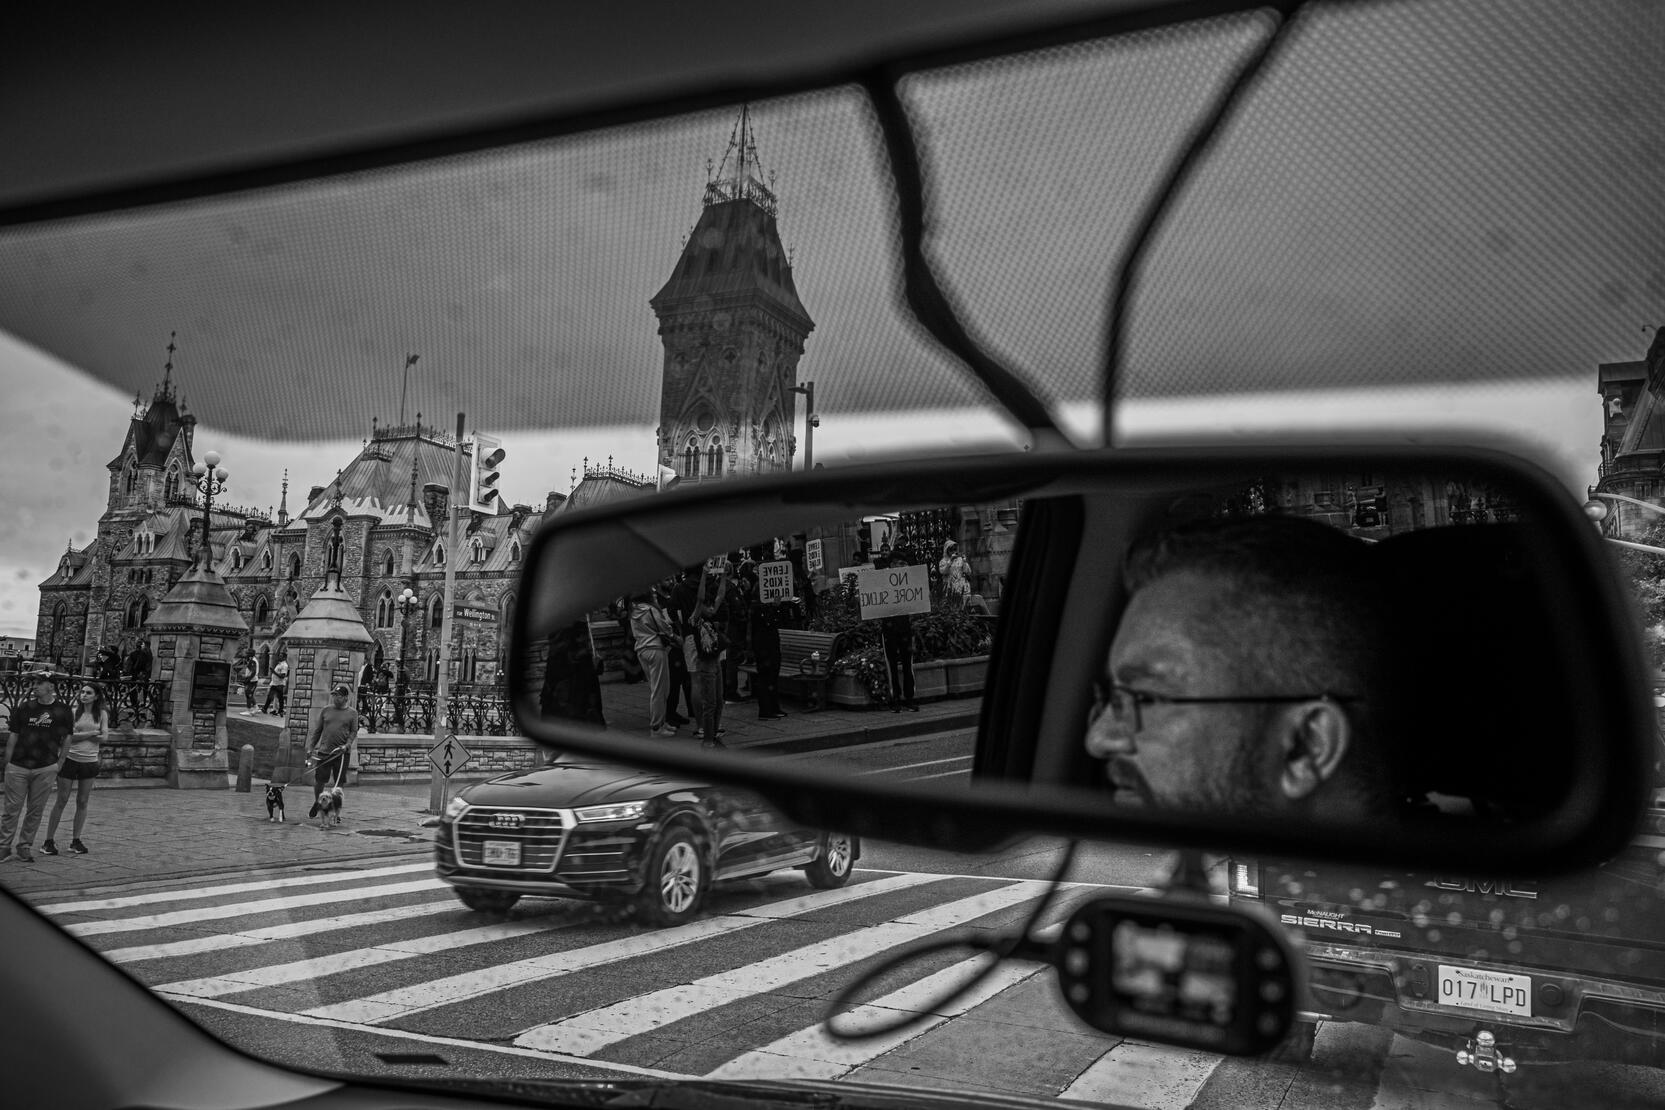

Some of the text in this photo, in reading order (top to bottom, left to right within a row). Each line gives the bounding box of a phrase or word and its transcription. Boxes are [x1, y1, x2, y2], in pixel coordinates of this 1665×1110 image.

[464, 608, 491, 621] Wellington
[1434, 876, 1538, 899] GMC
[1280, 914, 1372, 935] SIERRA
[1459, 970, 1510, 983] Saskatchewan
[1443, 979, 1477, 999] 017
[1490, 984, 1526, 1007] LPD
